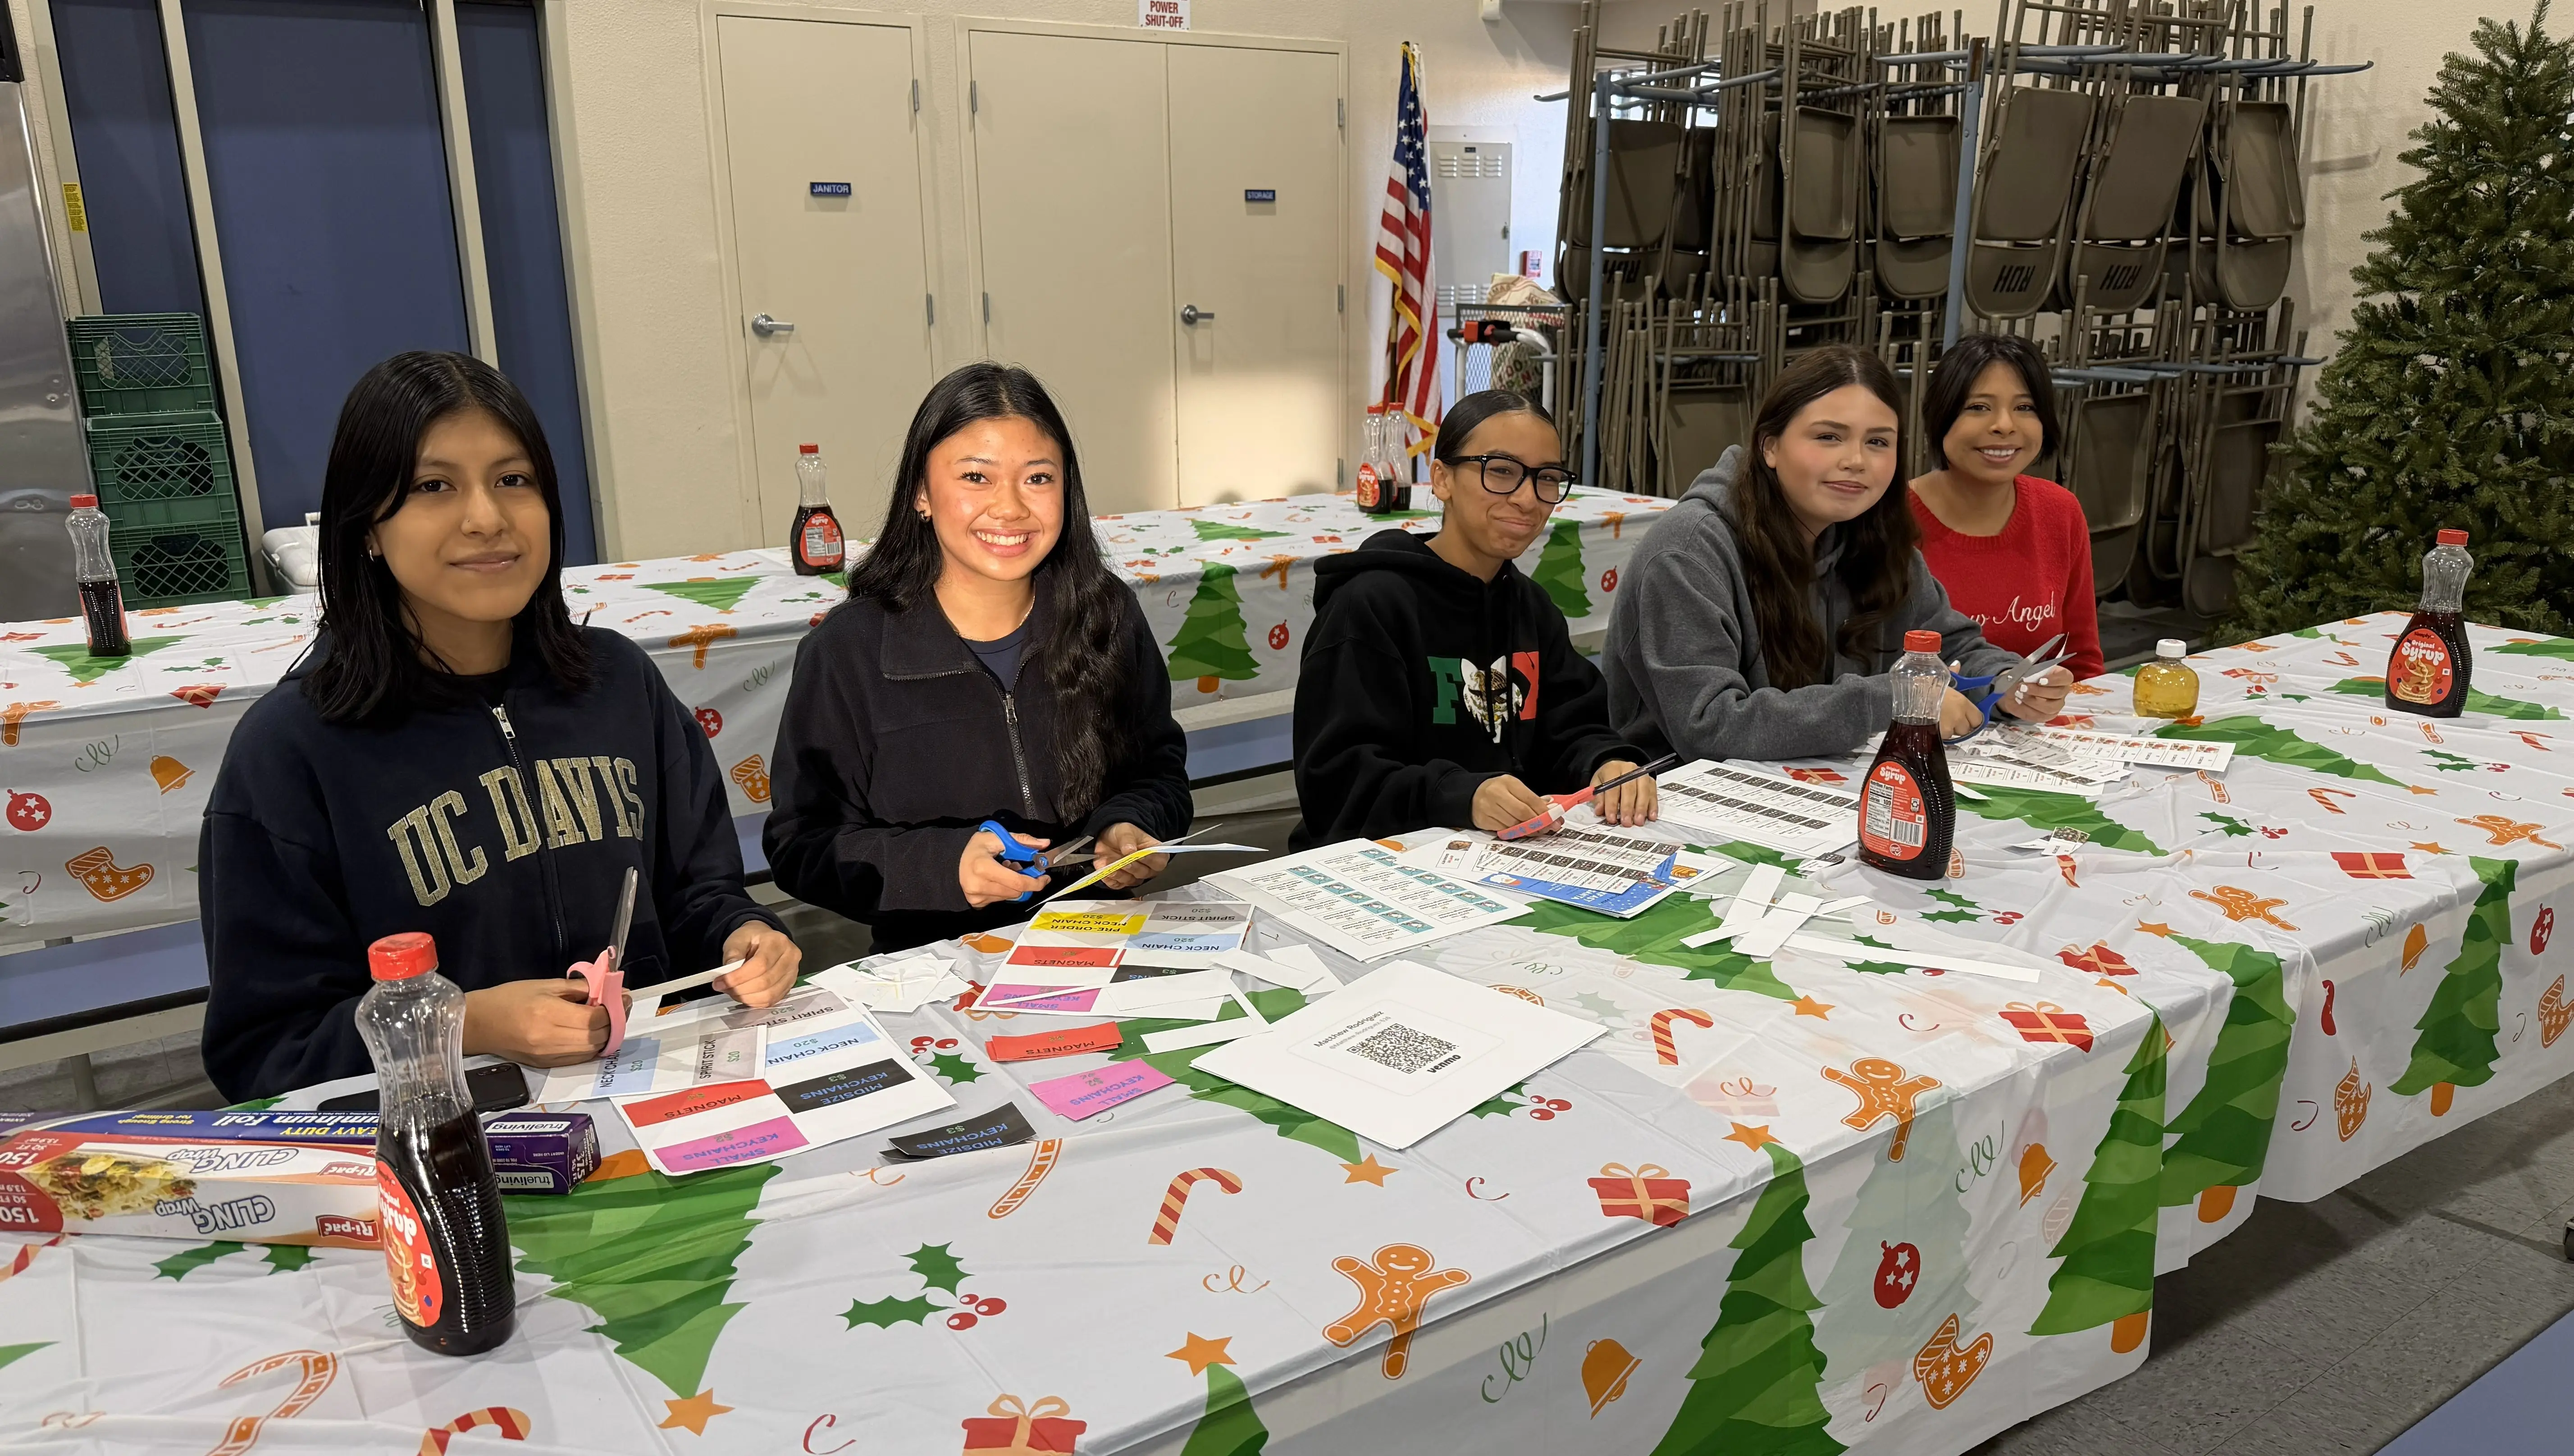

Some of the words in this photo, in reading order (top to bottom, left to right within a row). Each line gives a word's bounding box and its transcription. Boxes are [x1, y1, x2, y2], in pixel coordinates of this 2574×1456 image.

[1150, 1, 1178, 14] POWER
[1146, 14, 1183, 28] SHUT-OFF
[812, 184, 849, 193] JANITOR
[1993, 591, 2056, 631] Angel
[2411, 639, 2435, 649] Original
[2401, 642, 2445, 666] Syrup
[1880, 766, 1906, 785] Syrup
[387, 790, 488, 906] UC
[479, 756, 645, 863] DAVIS
[771, 1006, 796, 1015] $20
[1017, 1001, 1059, 1009] SMALL
[794, 1006, 834, 1021] SPIRIT
[1313, 1028, 1349, 1048] Matthew
[1346, 1011, 1384, 1031] Rodriguez
[703, 1039, 716, 1060] STICK
[793, 1038, 818, 1048] $20
[819, 1038, 859, 1052] NECK
[1026, 1041, 1095, 1055] MAGNETS
[727, 1050, 740, 1063] $20
[767, 1048, 816, 1065] CHAIN
[1427, 1054, 1461, 1073] venmo
[630, 1060, 644, 1072] $20
[699, 1060, 712, 1079] SPIRIT
[600, 1068, 615, 1088] NECK
[828, 1073, 847, 1082] $3
[800, 1072, 888, 1100] KEYCHAINS
[821, 1082, 883, 1105] MIDSIZE
[1070, 1075, 1145, 1105] KEYCHAINS
[1098, 1087, 1143, 1105] SMALL
[664, 1095, 742, 1118] MAGNETS
[212, 1115, 269, 1126] Foil
[273, 1115, 379, 1126] uminum
[492, 1123, 564, 1132] trueliving
[279, 1127, 330, 1135] DUTY
[332, 1127, 378, 1135] EAVY
[916, 1122, 1008, 1150] KEYCHAINS
[946, 1125, 965, 1134] $3
[683, 1132, 779, 1160] KEYCHAINS
[937, 1137, 1003, 1156] MIDSIZE
[0, 1152, 39, 1165] 150
[166, 1148, 220, 1161] Wrap
[189, 1148, 299, 1173] CLING
[708, 1147, 766, 1165] SMALL
[326, 1164, 377, 1177] Ri-pac
[576, 1151, 585, 1179] 37.5
[495, 1174, 551, 1186] trueliving
[6, 1184, 26, 1192] 13.9
[13, 1196, 27, 1204] SQ
[155, 1197, 201, 1216] Wrap
[0, 1206, 40, 1223] 150
[191, 1195, 275, 1234] CLING
[379, 1196, 417, 1246] yrup
[324, 1222, 374, 1237] Ri-pac
